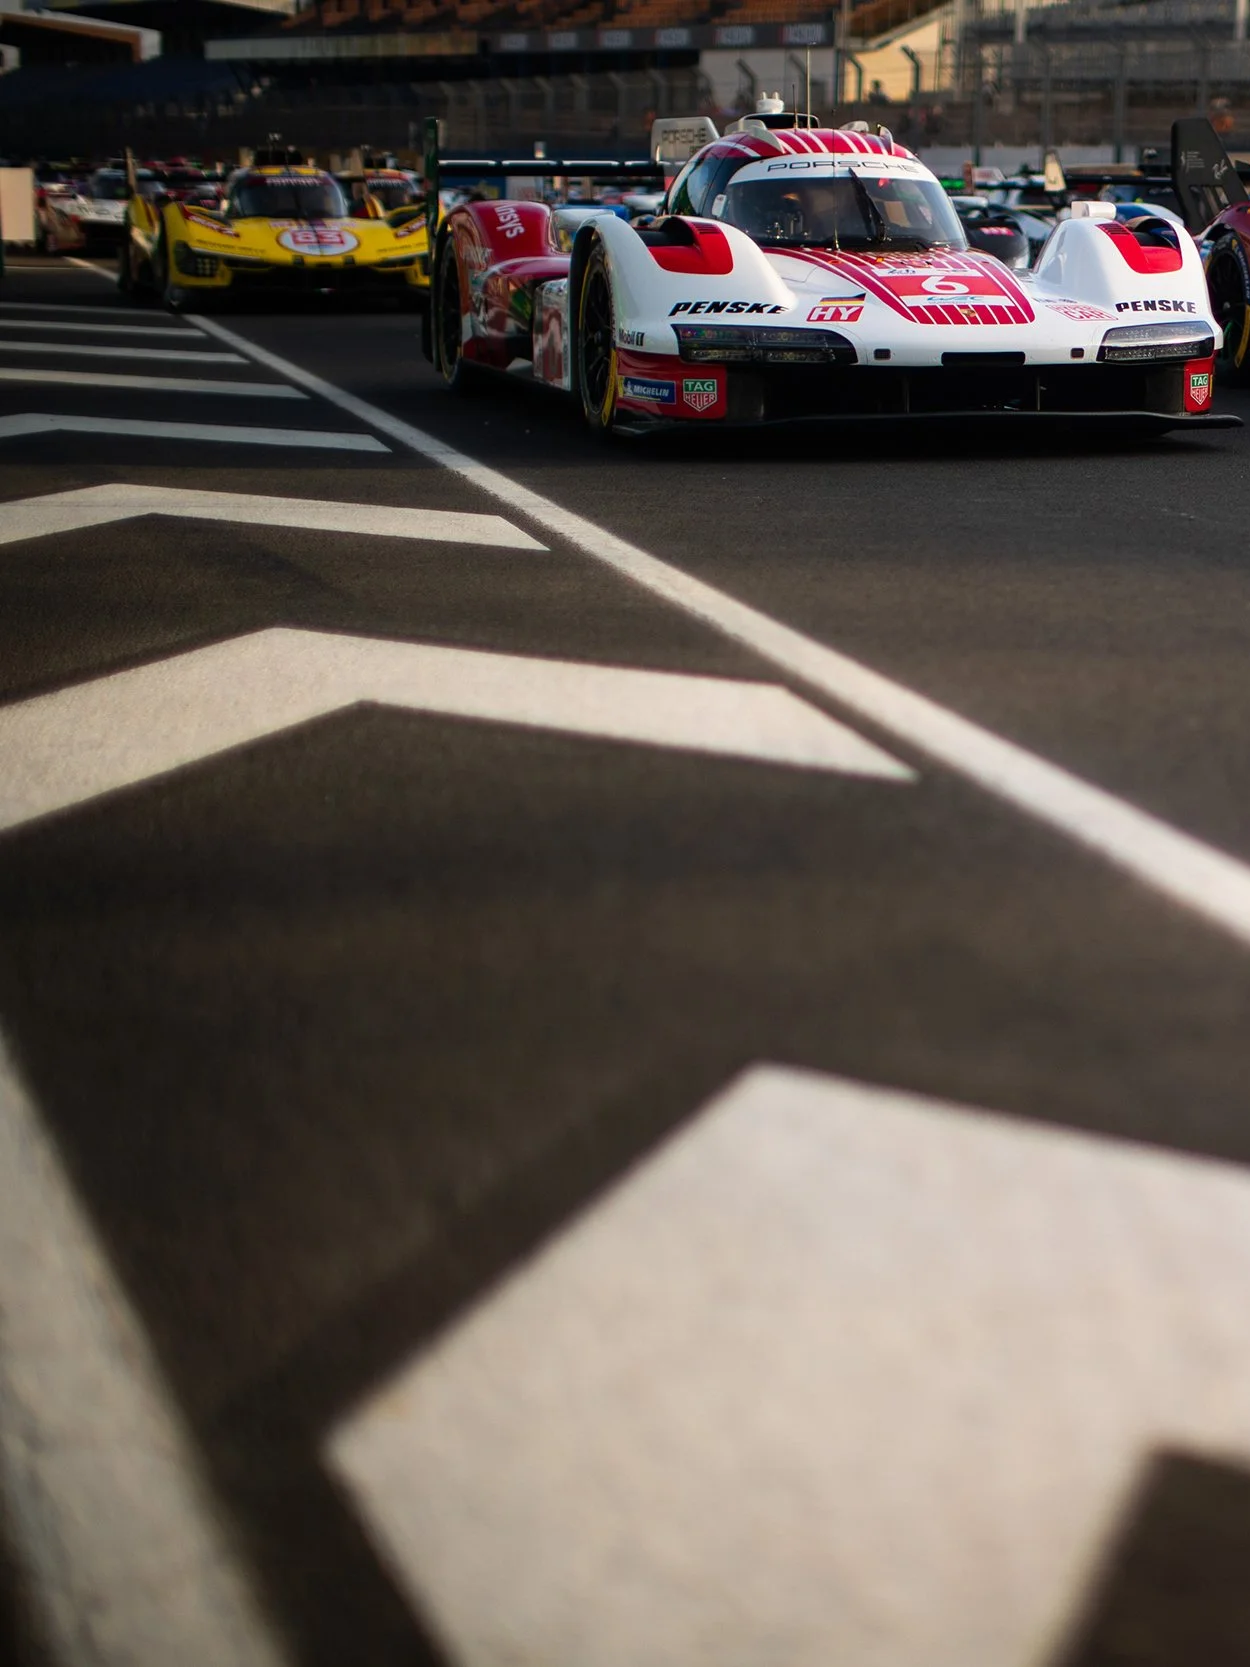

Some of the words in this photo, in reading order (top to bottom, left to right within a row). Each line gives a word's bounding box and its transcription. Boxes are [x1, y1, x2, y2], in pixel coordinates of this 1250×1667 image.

[661, 127, 706, 143] PORSCHE
[767, 160, 919, 173] PORSCHE
[921, 276, 970, 295] 6
[668, 301, 790, 317] PENSKE
[809, 306, 861, 320] HY
[1115, 299, 1197, 314] PENSKE
[685, 381, 714, 391] TAG
[1192, 376, 1208, 386] TAG
[632, 384, 669, 398] MICHELIN
[1191, 387, 1208, 403] HEUER
[685, 392, 715, 409] HEUER
